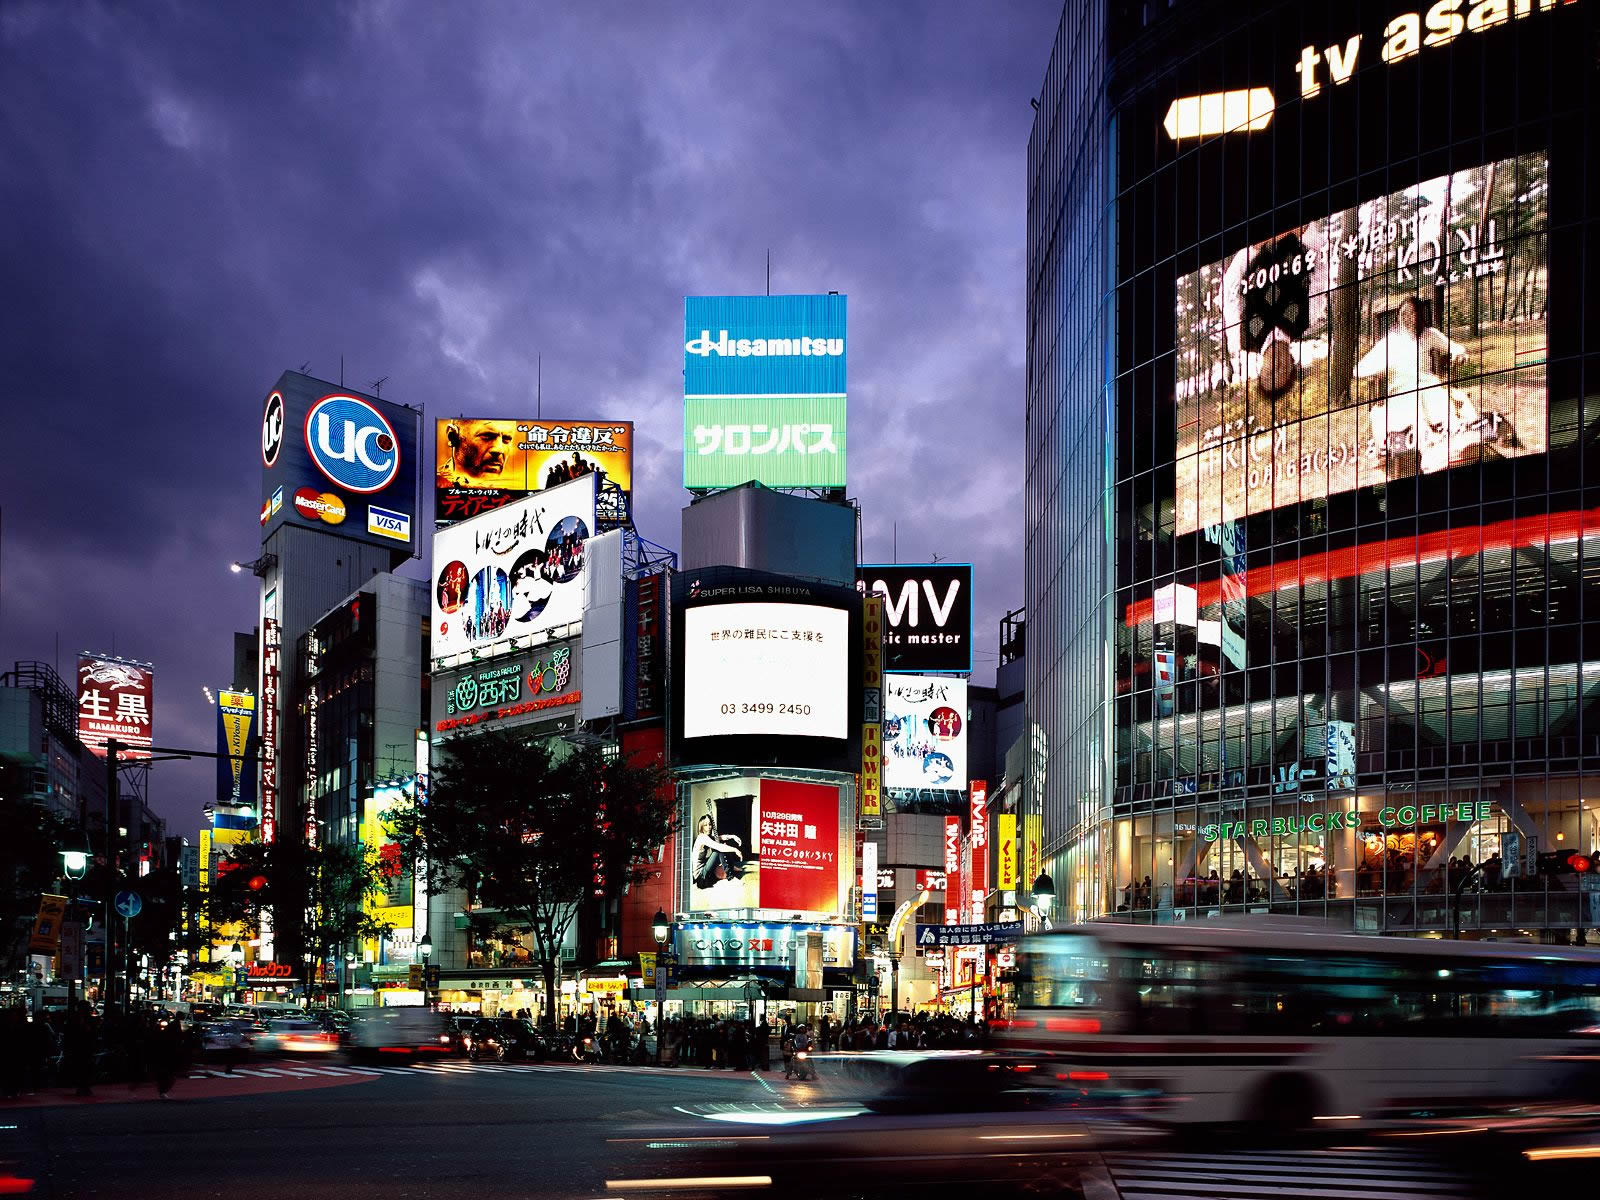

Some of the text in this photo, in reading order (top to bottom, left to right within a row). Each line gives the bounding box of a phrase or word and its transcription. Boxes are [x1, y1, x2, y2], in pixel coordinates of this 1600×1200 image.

[1295, 33, 1362, 99] tv
[685, 329, 844, 357] Hisamitsu
[693, 423, 838, 455] サロンパス
[295, 495, 346, 517] MasterCard
[376, 515, 402, 532] VISA
[700, 586, 811, 598] SUPER LISA SHIBUYA
[865, 603, 879, 682] TOKYO
[908, 632, 961, 644] master
[479, 675, 521, 706] 西村
[78, 688, 149, 725] 生黒
[720, 703, 811, 715] 03 3499 2450
[88, 721, 140, 735] NAMAKURO
[863, 727, 880, 807] TOWER
[761, 820, 799, 838] 矢井田
[1204, 809, 1361, 842] STARBUCKS
[1378, 801, 1492, 826] COFFEE
[776, 839, 797, 847] ALBUM
